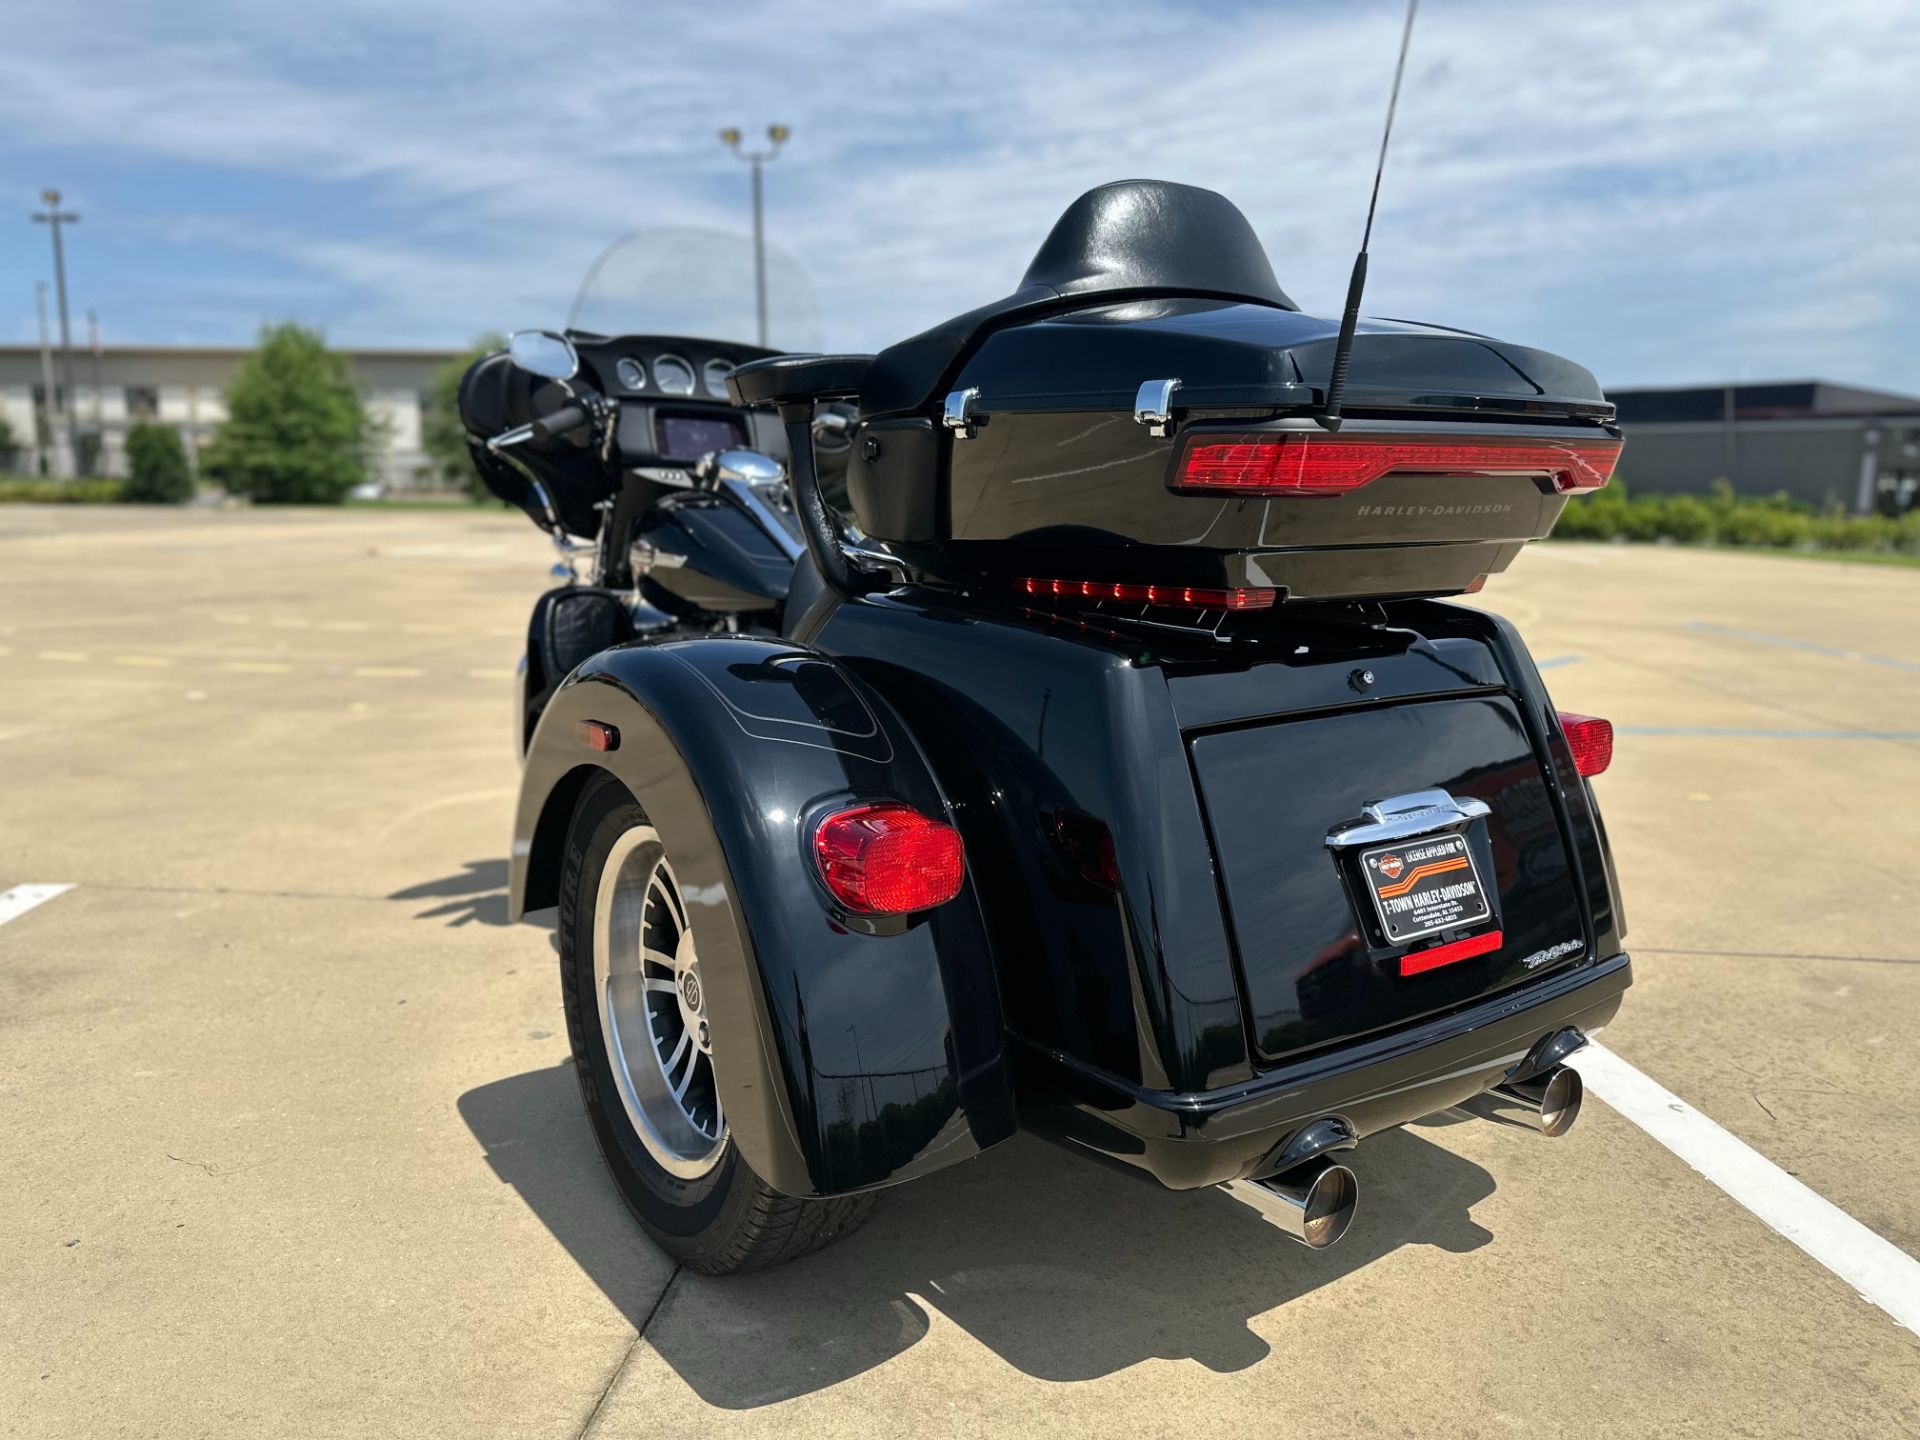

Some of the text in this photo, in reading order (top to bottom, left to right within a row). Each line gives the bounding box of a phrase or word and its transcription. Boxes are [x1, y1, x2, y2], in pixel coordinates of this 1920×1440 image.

[1357, 503, 1513, 516] HARLEY-DAVIDSON
[1405, 842, 1457, 862] LICENSE APPLIED FOR
[1383, 895, 1414, 915] T-TOWN
[562, 842, 599, 1101] SIGNATURE
